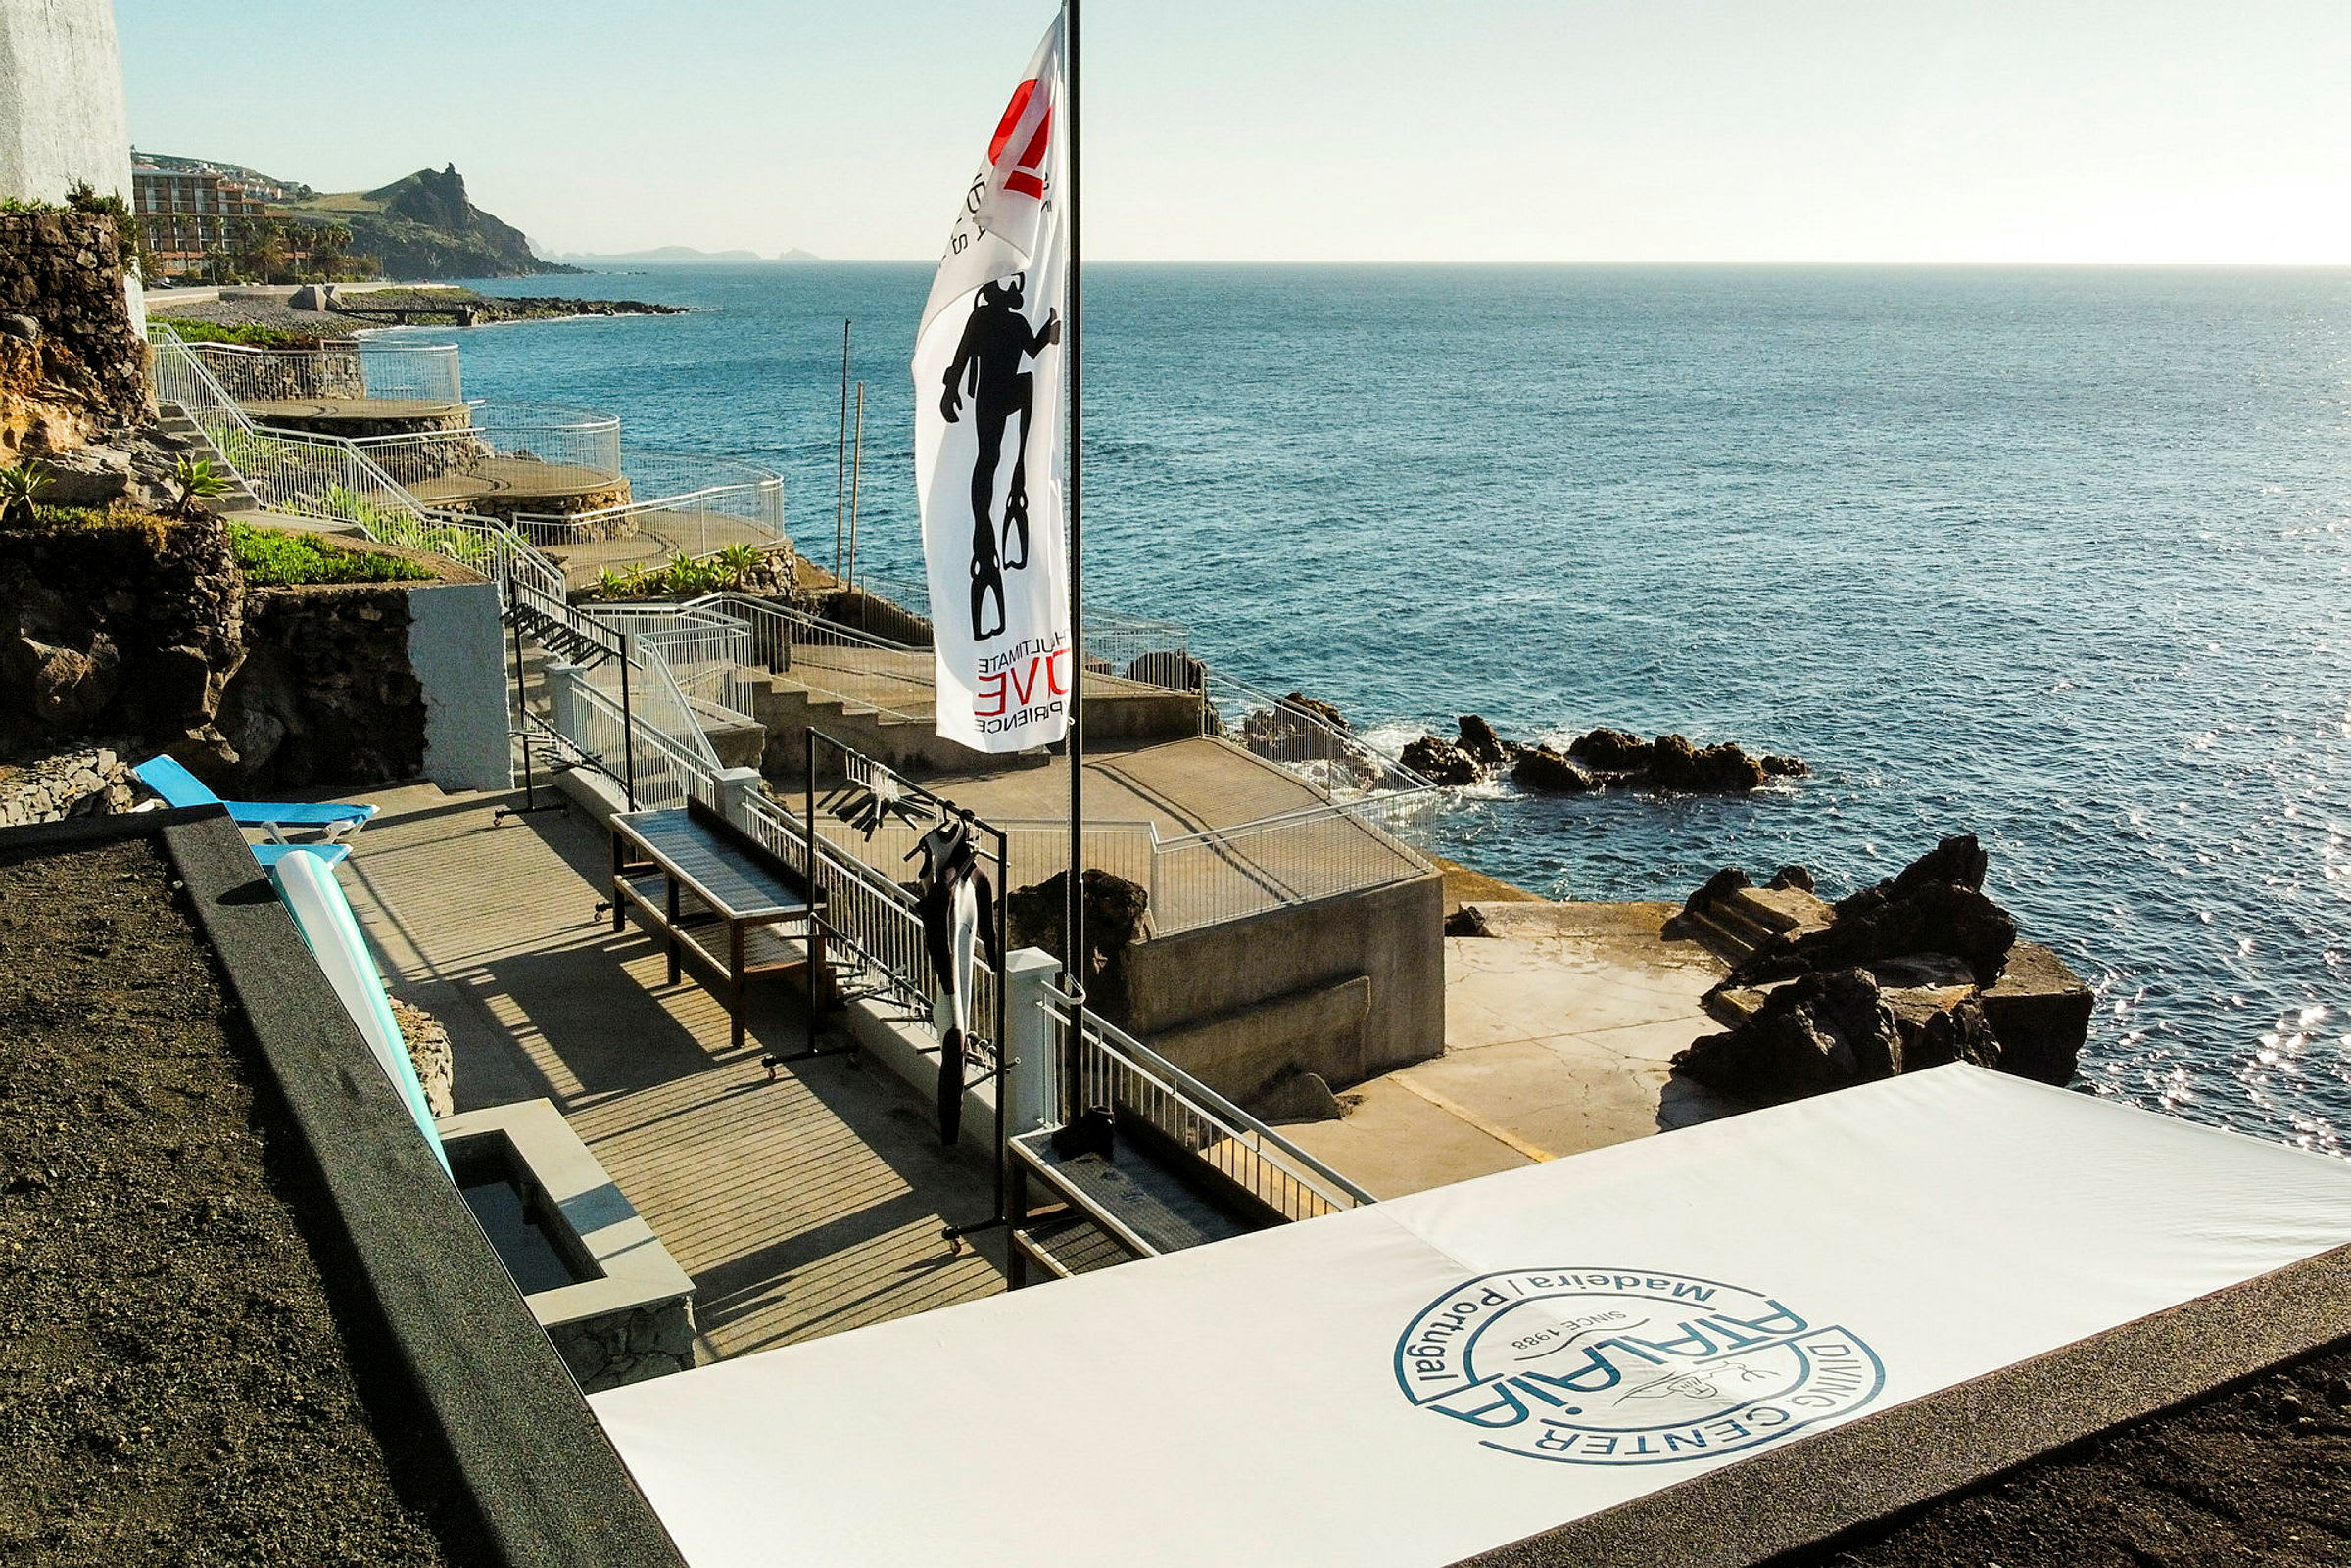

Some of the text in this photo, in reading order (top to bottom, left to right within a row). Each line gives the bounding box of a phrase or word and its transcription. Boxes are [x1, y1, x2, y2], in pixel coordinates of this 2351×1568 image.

[1531, 1274, 1716, 1303] Madeira
[1406, 1287, 1509, 1381] Portugal
[1511, 1310, 1627, 1351] SINCE 1988
[1534, 1344, 1862, 1456] DIVING CENTER
